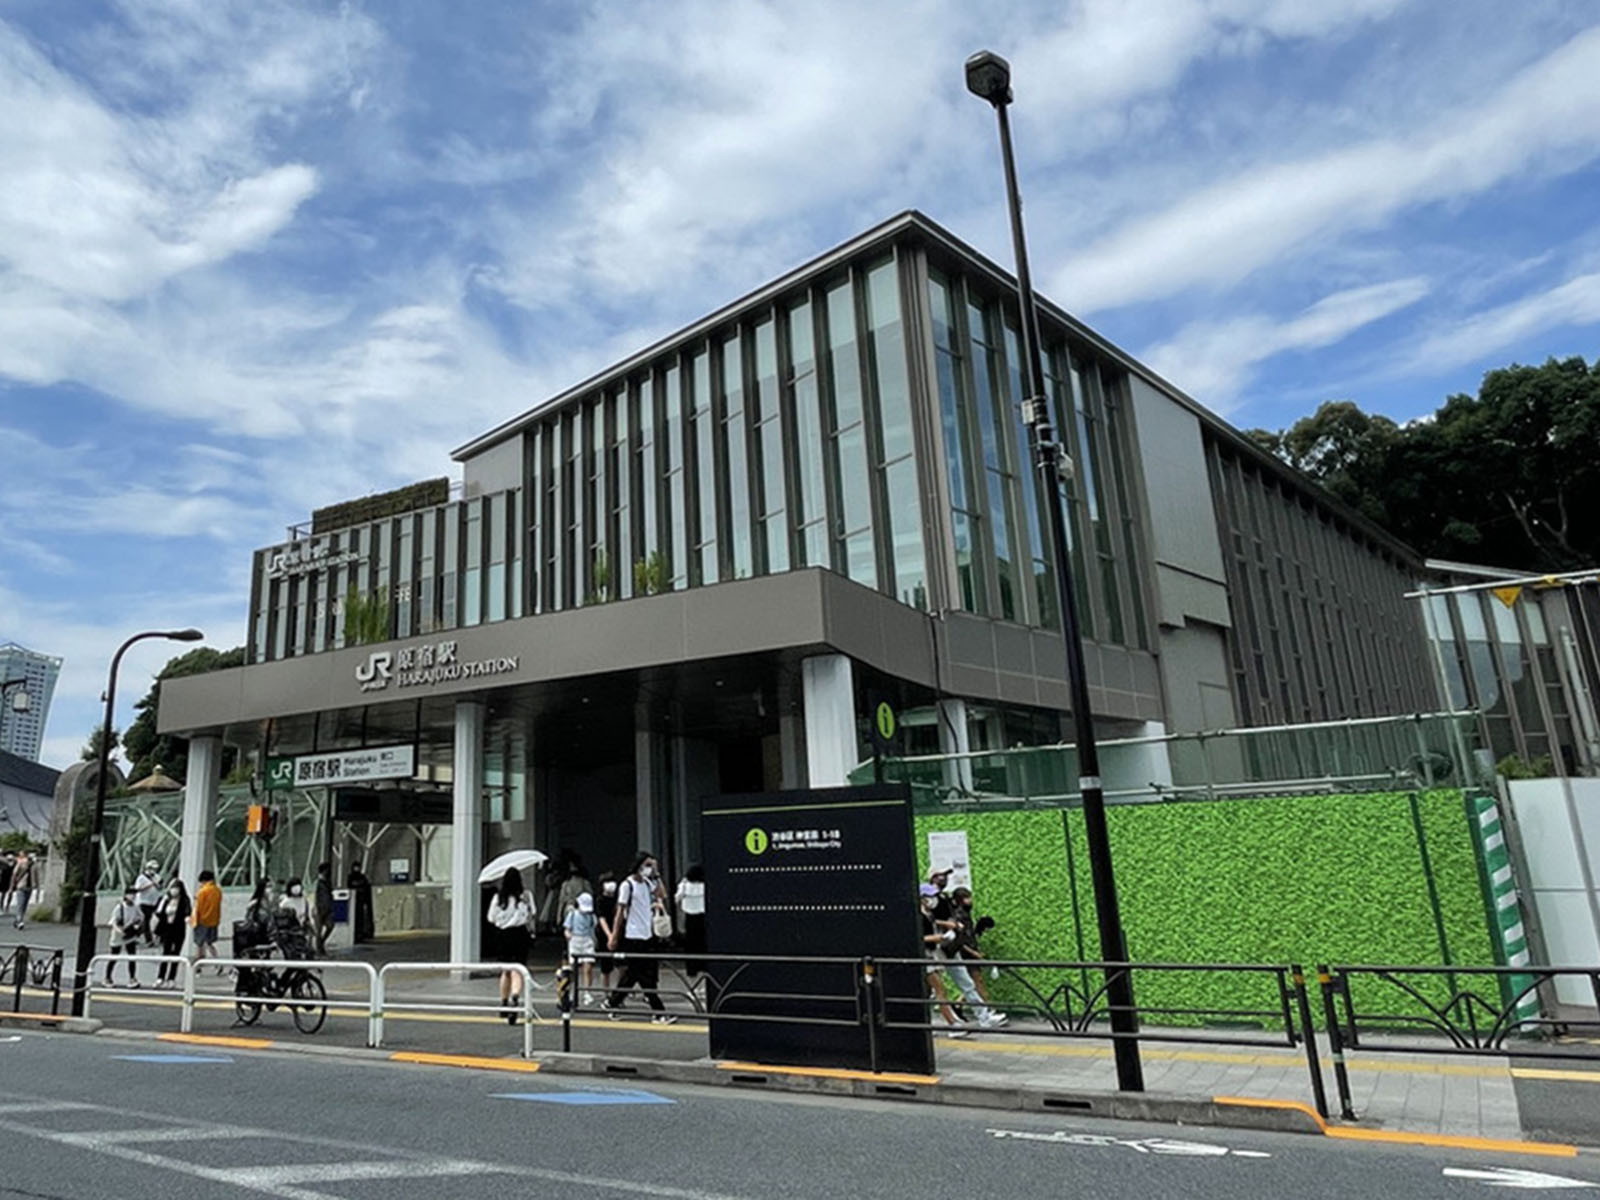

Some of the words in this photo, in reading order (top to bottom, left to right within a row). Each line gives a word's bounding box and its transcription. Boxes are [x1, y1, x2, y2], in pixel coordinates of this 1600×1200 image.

[398, 640, 457, 669] 原宿駅
[355, 651, 392, 682] JR
[396, 664, 461, 688] HARAJUKU
[462, 655, 518, 678] STATION
[272, 761, 293, 779] JR
[298, 758, 341, 781] 原宿駅
[343, 767, 370, 777] Station
[344, 755, 377, 767] Harajuku
